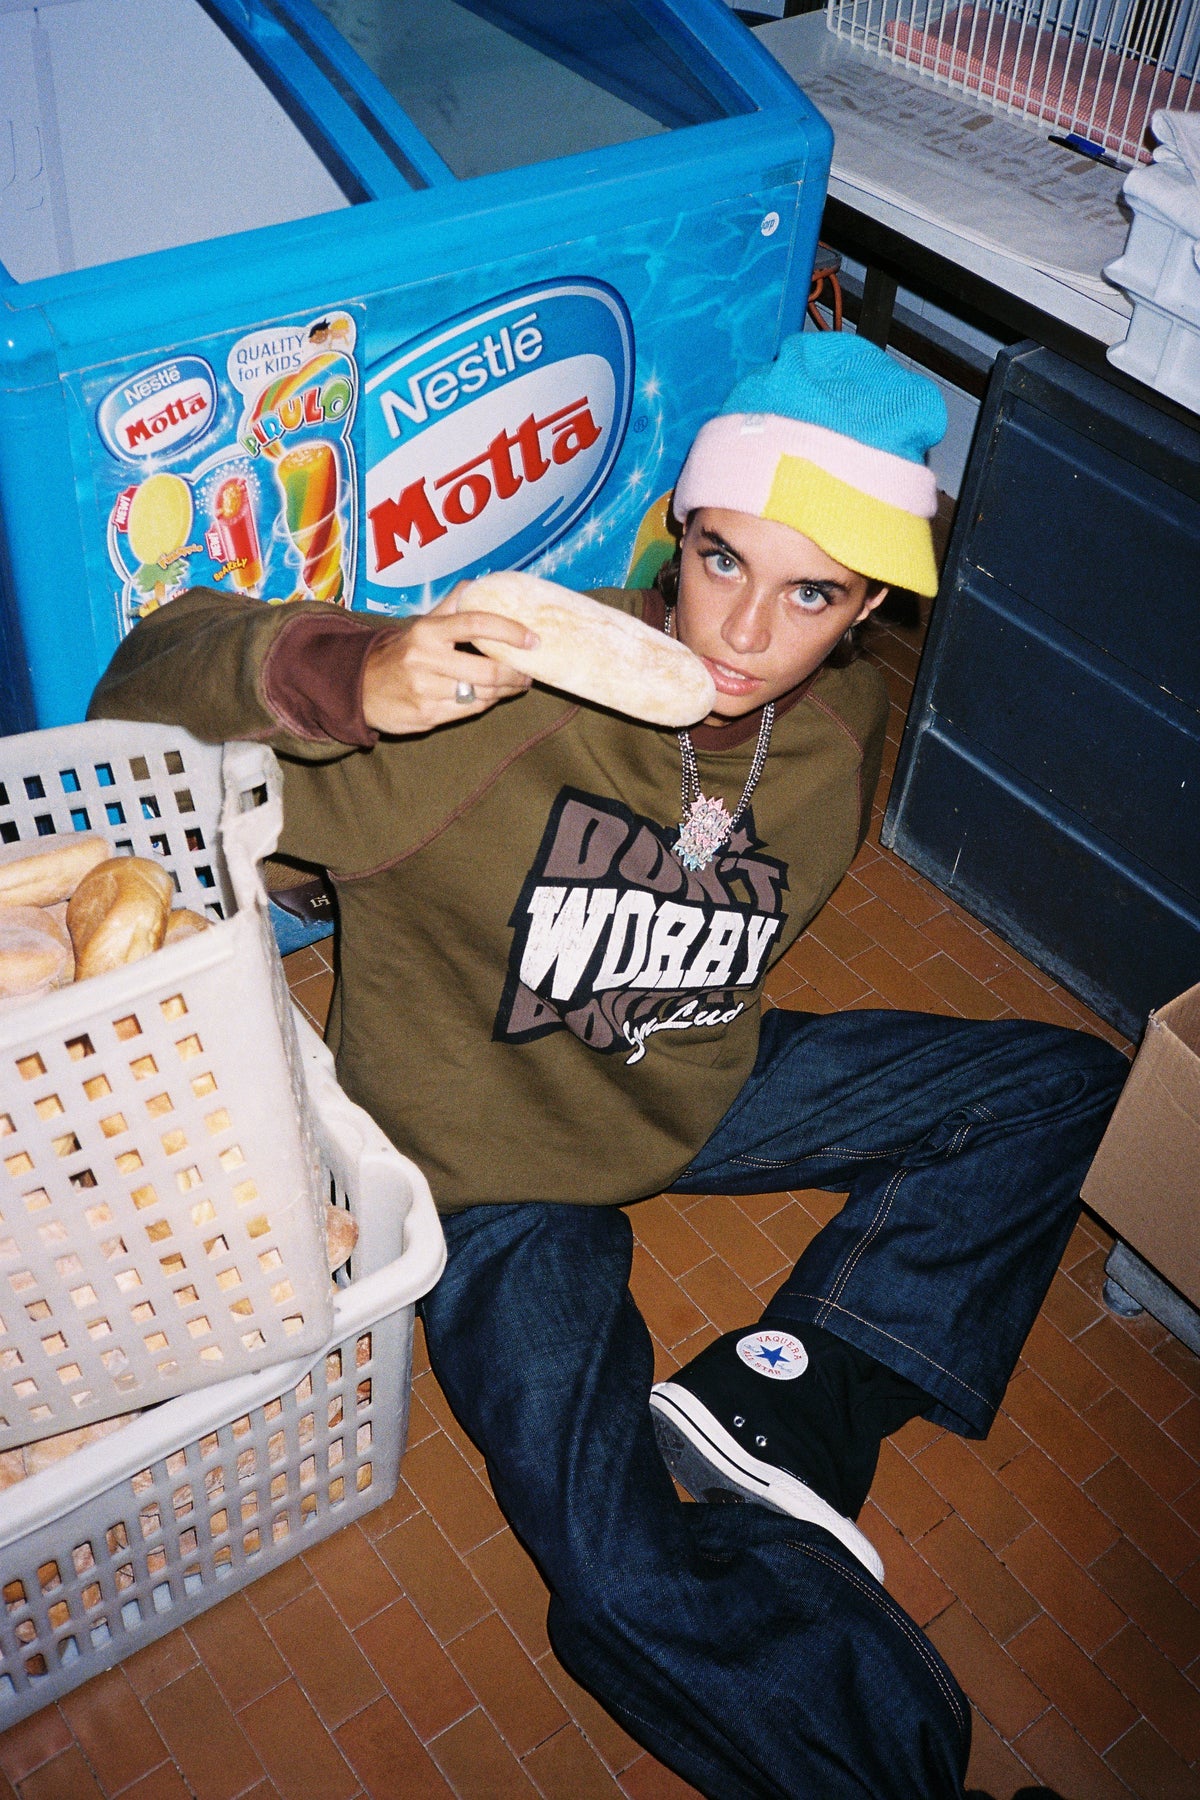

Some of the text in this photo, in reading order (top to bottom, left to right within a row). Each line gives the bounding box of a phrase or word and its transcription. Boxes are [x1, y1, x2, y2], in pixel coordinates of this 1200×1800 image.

[236, 333, 305, 364] QUALITY
[239, 352, 301, 381] for KIDS
[379, 313, 543, 439] Nestlé
[123, 365, 181, 406] Nestlé
[125, 392, 207, 449] Motta
[241, 376, 353, 457] PIRULO
[367, 396, 602, 573] Motta
[519, 886, 779, 1001] WORRY
[756, 1335, 802, 1360] VAQUERA
